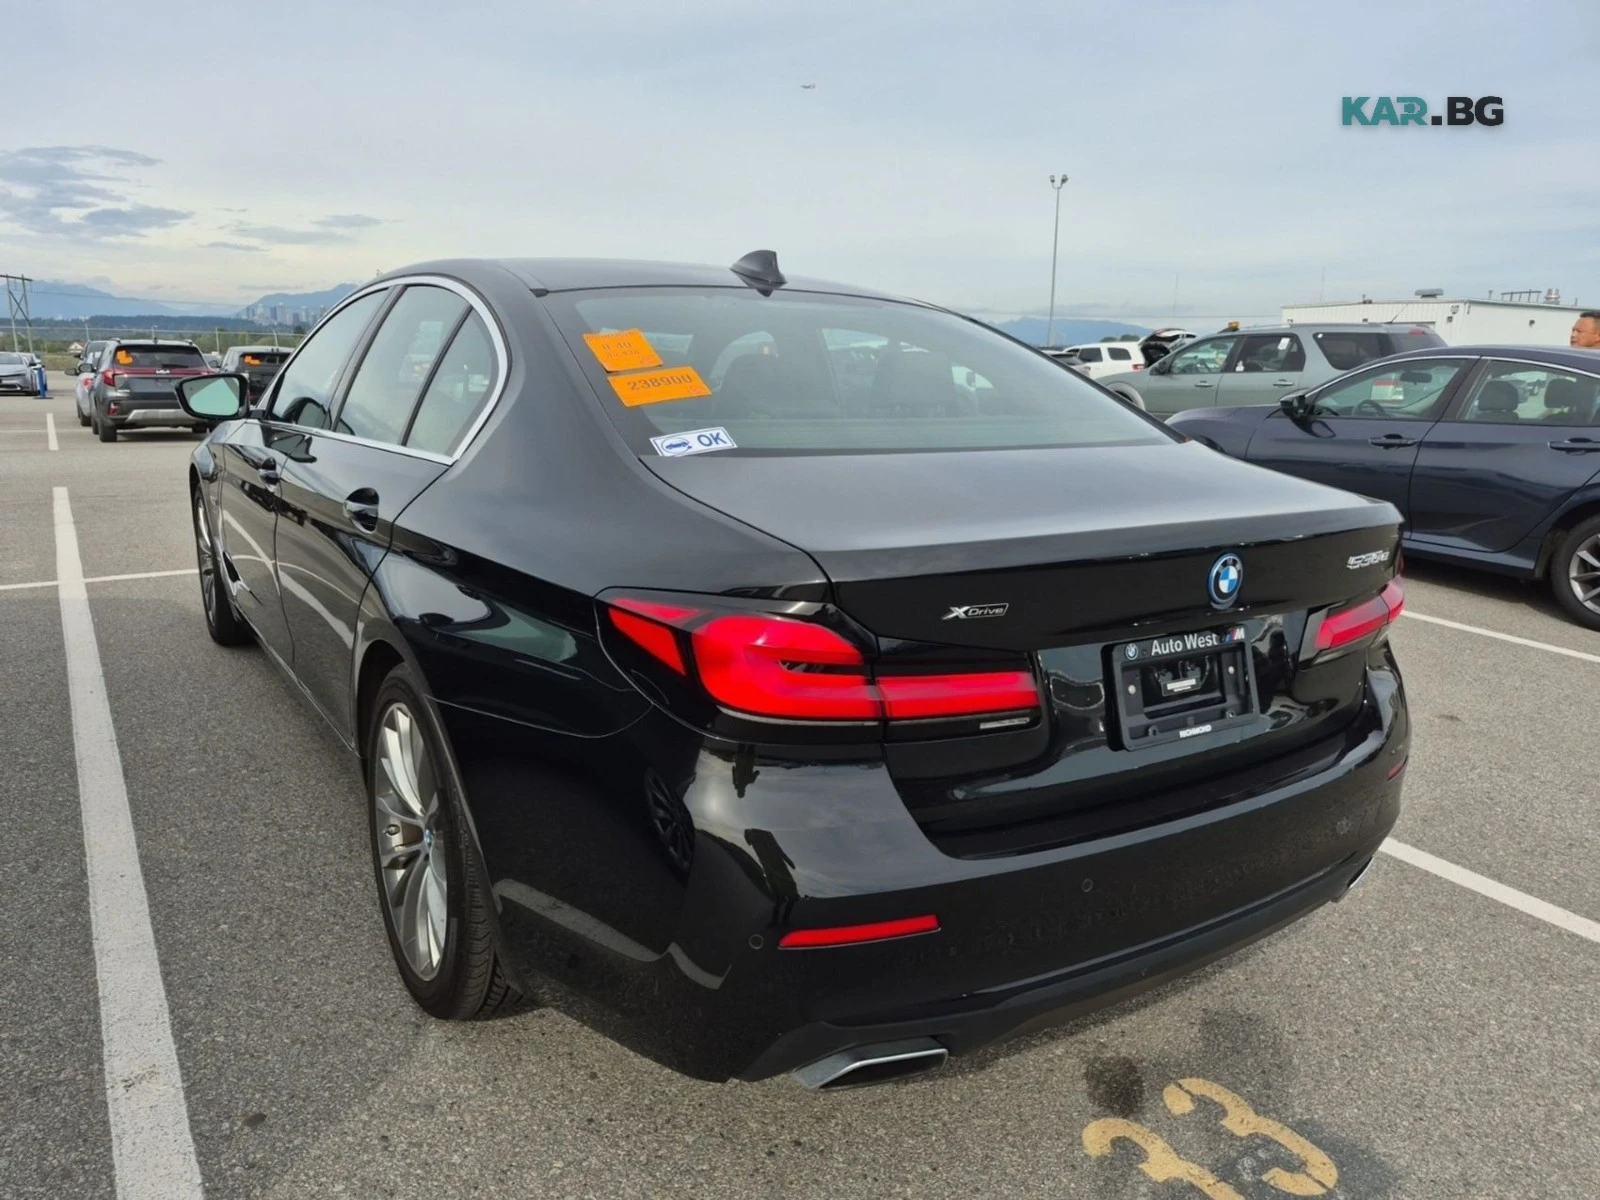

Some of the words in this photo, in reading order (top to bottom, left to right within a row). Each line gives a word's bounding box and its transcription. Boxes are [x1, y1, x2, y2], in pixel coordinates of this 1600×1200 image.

[697, 432, 728, 448] OK
[1151, 639, 1183, 656] Auto
[1184, 633, 1218, 650] West
